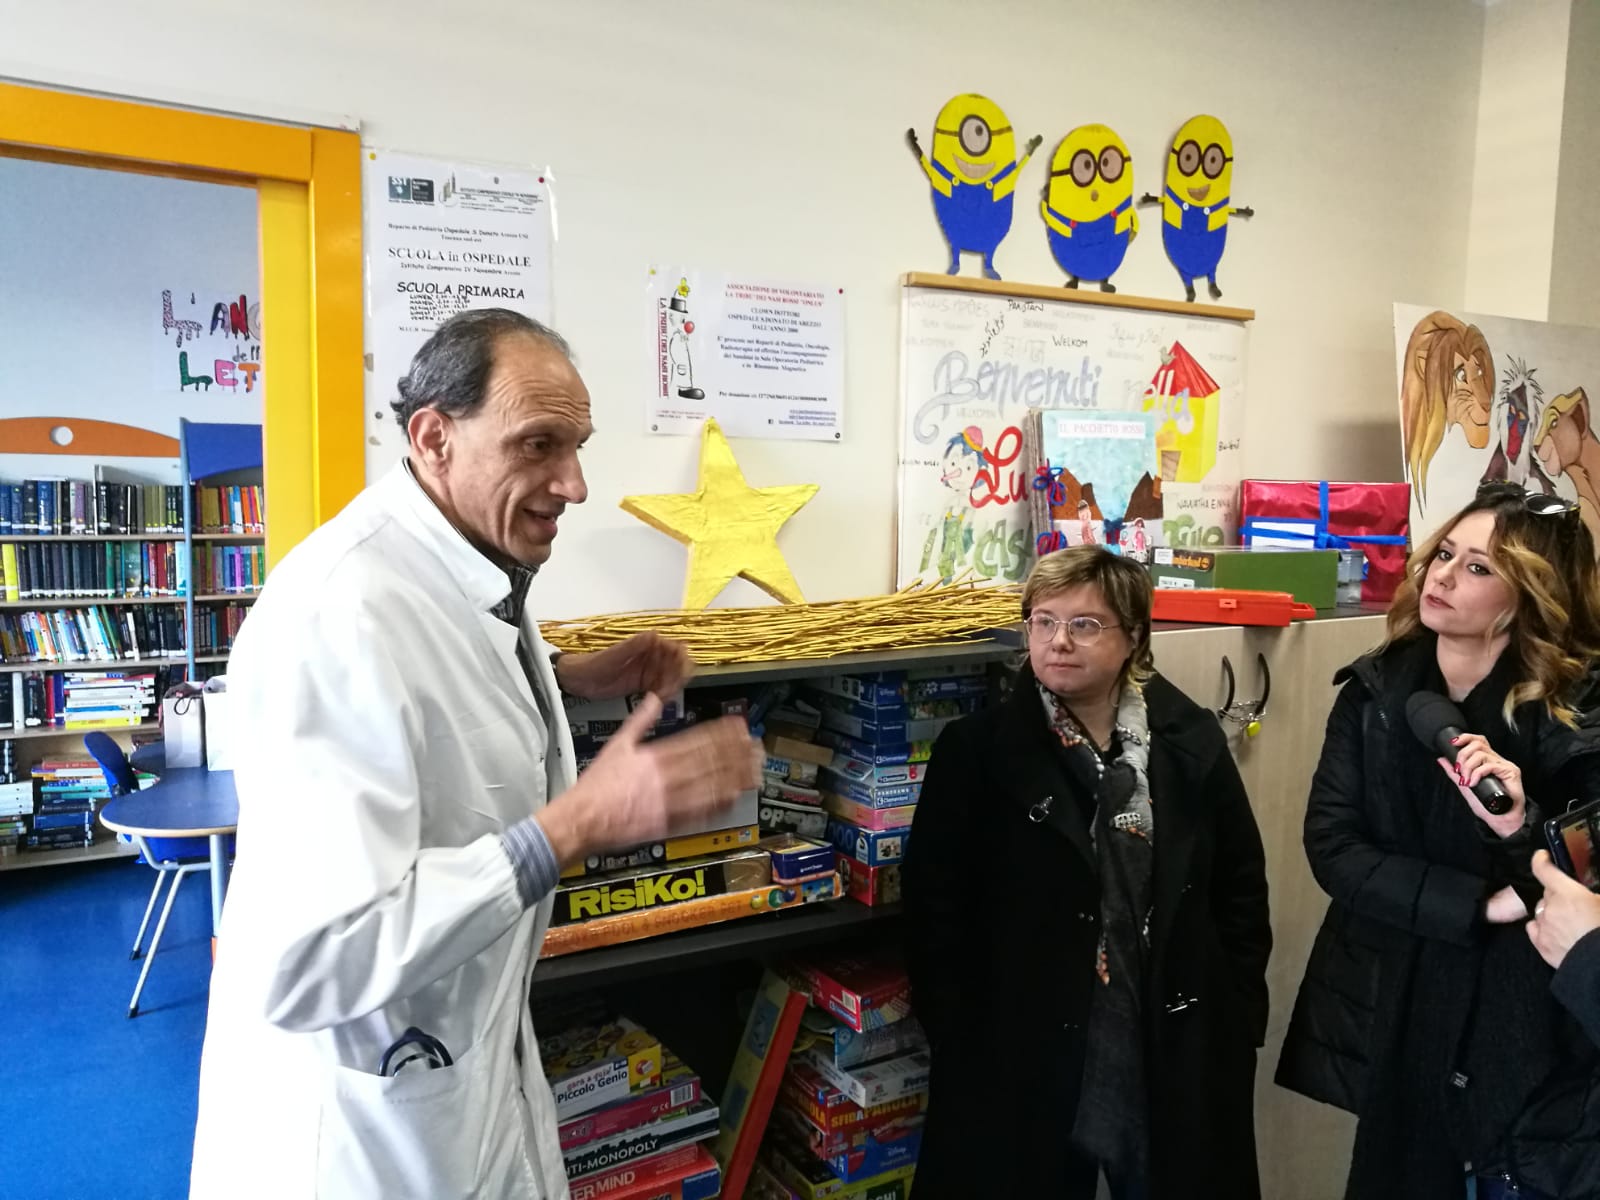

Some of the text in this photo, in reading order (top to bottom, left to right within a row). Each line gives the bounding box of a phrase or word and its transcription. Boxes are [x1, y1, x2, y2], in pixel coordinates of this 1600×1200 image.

[388, 247, 532, 268] SCUOLA in OSPEDALE
[396, 281, 525, 300] SCUOLA PRIMARIA
[727, 284, 769, 292] ASSOCIAZIONE
[779, 289, 824, 298] VOLONTARIATO
[728, 314, 759, 322] OSPEDALE
[751, 307, 801, 318] CLOWN DOTTORI
[1052, 335, 1088, 347] WELKOM
[913, 350, 1101, 443] Benvenuti
[569, 868, 706, 921] RisiKo!
[557, 1069, 629, 1105] Piccolo Genio
[595, 1169, 637, 1193] MIND
